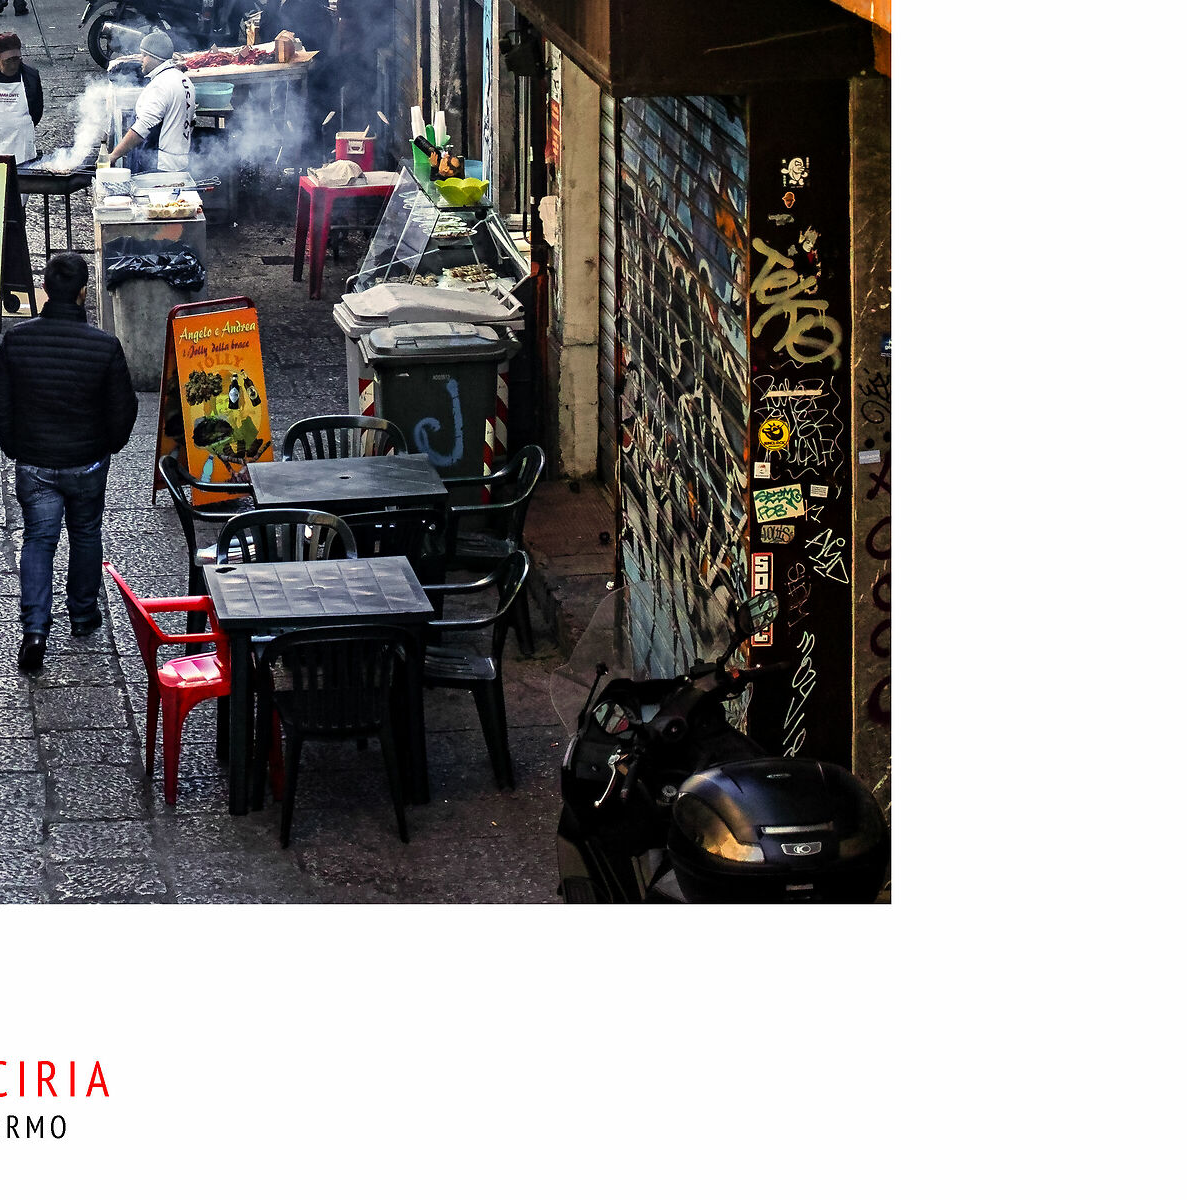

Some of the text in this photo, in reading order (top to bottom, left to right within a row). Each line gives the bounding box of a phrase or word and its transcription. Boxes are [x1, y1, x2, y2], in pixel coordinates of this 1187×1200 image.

[178, 320, 256, 344] Angelo e Andrea
[187, 345, 208, 358] Jolly
[211, 342, 229, 353] della
[230, 339, 249, 350] brace
[197, 353, 244, 370] JOLLY
